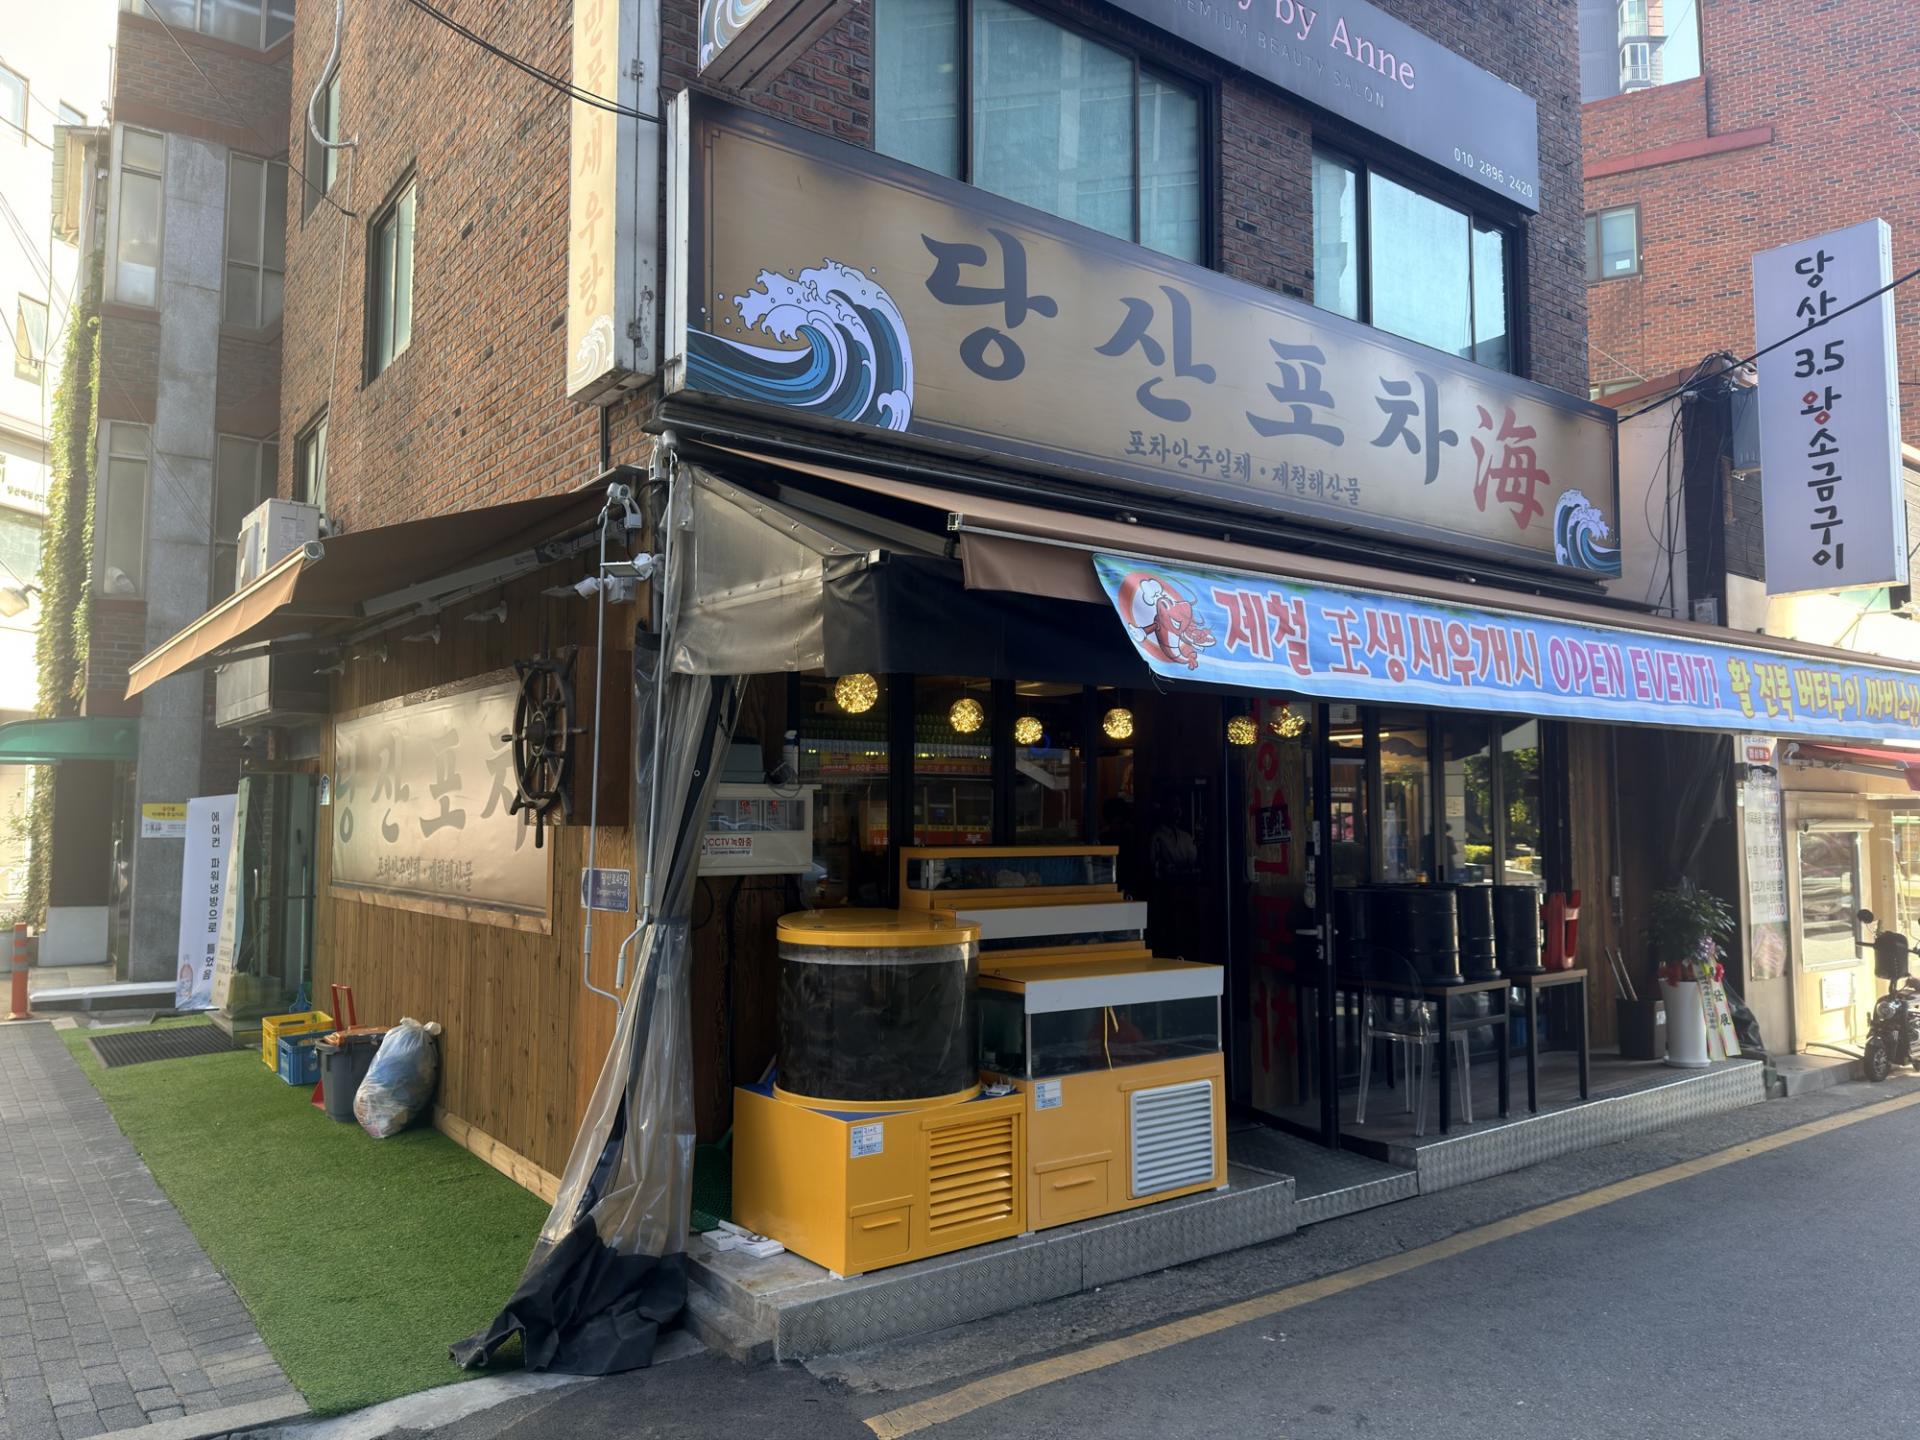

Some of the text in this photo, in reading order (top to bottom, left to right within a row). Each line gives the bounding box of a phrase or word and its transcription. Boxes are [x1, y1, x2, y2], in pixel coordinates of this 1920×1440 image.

[1257, 34, 1327, 76] BEAUTY
[1333, 70, 1386, 109] SALON
[1275, 0, 1416, 90] by Anne
[1509, 175, 1533, 198] 2420
[1794, 249, 1837, 329] 당산
[920, 227, 1551, 531] 당산포차 海
[1793, 339, 1845, 378] 3.5
[1124, 429, 1362, 506] 포차안주일체 제철해산물
[1799, 385, 1844, 571] 왕소금구이
[1210, 584, 1313, 676] 제철
[1549, 635, 1626, 699] OPEN
[1628, 646, 1721, 710] EVENT!
[1727, 655, 1755, 719] 활
[1753, 660, 1795, 723] 전복
[1792, 667, 1862, 722] 버터구이
[210, 811, 221, 849] 에어컨
[207, 857, 220, 933] 파워냉방으로
